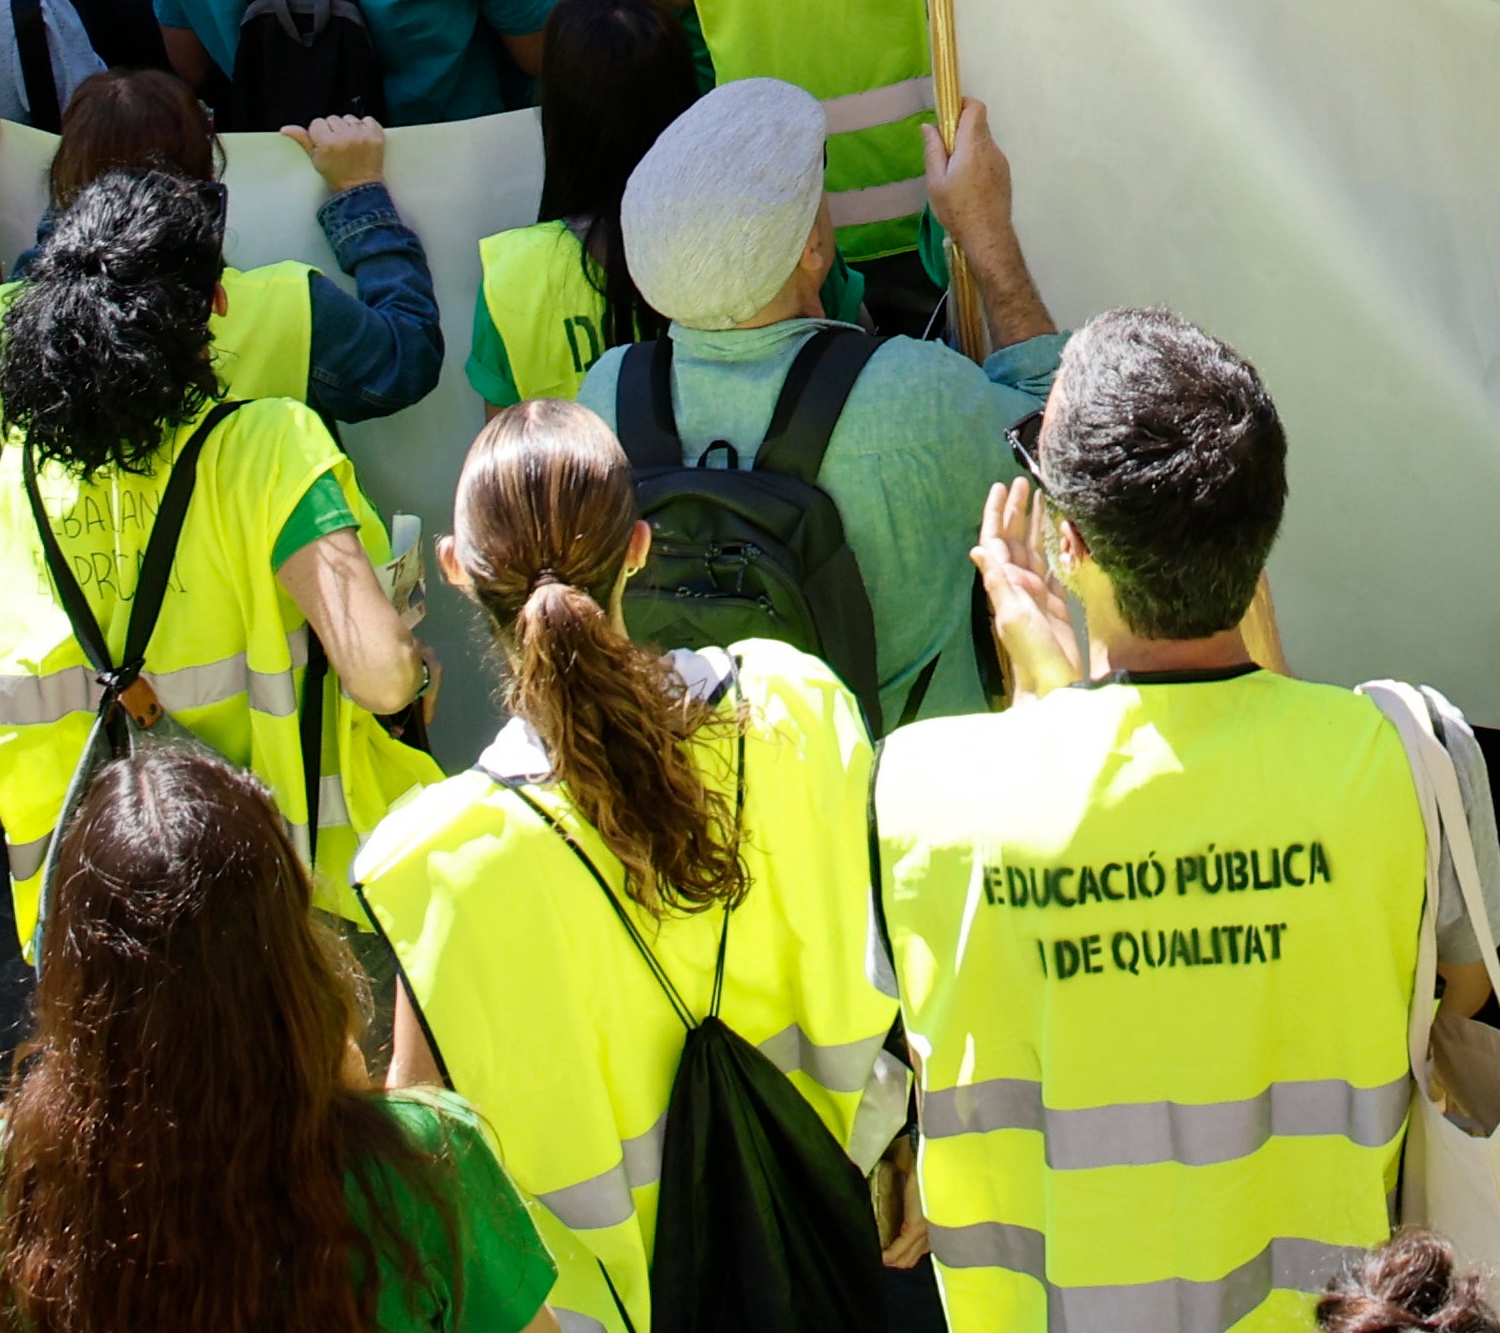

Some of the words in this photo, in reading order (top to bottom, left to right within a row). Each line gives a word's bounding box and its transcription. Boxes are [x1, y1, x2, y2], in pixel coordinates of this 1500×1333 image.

[982, 849, 1166, 908] EDUCACIÓ
[1176, 841, 1332, 898] PÚBLICA
[1037, 938, 1049, 980] I
[1055, 933, 1104, 981] DE
[1112, 922, 1287, 976] QUALITAT
